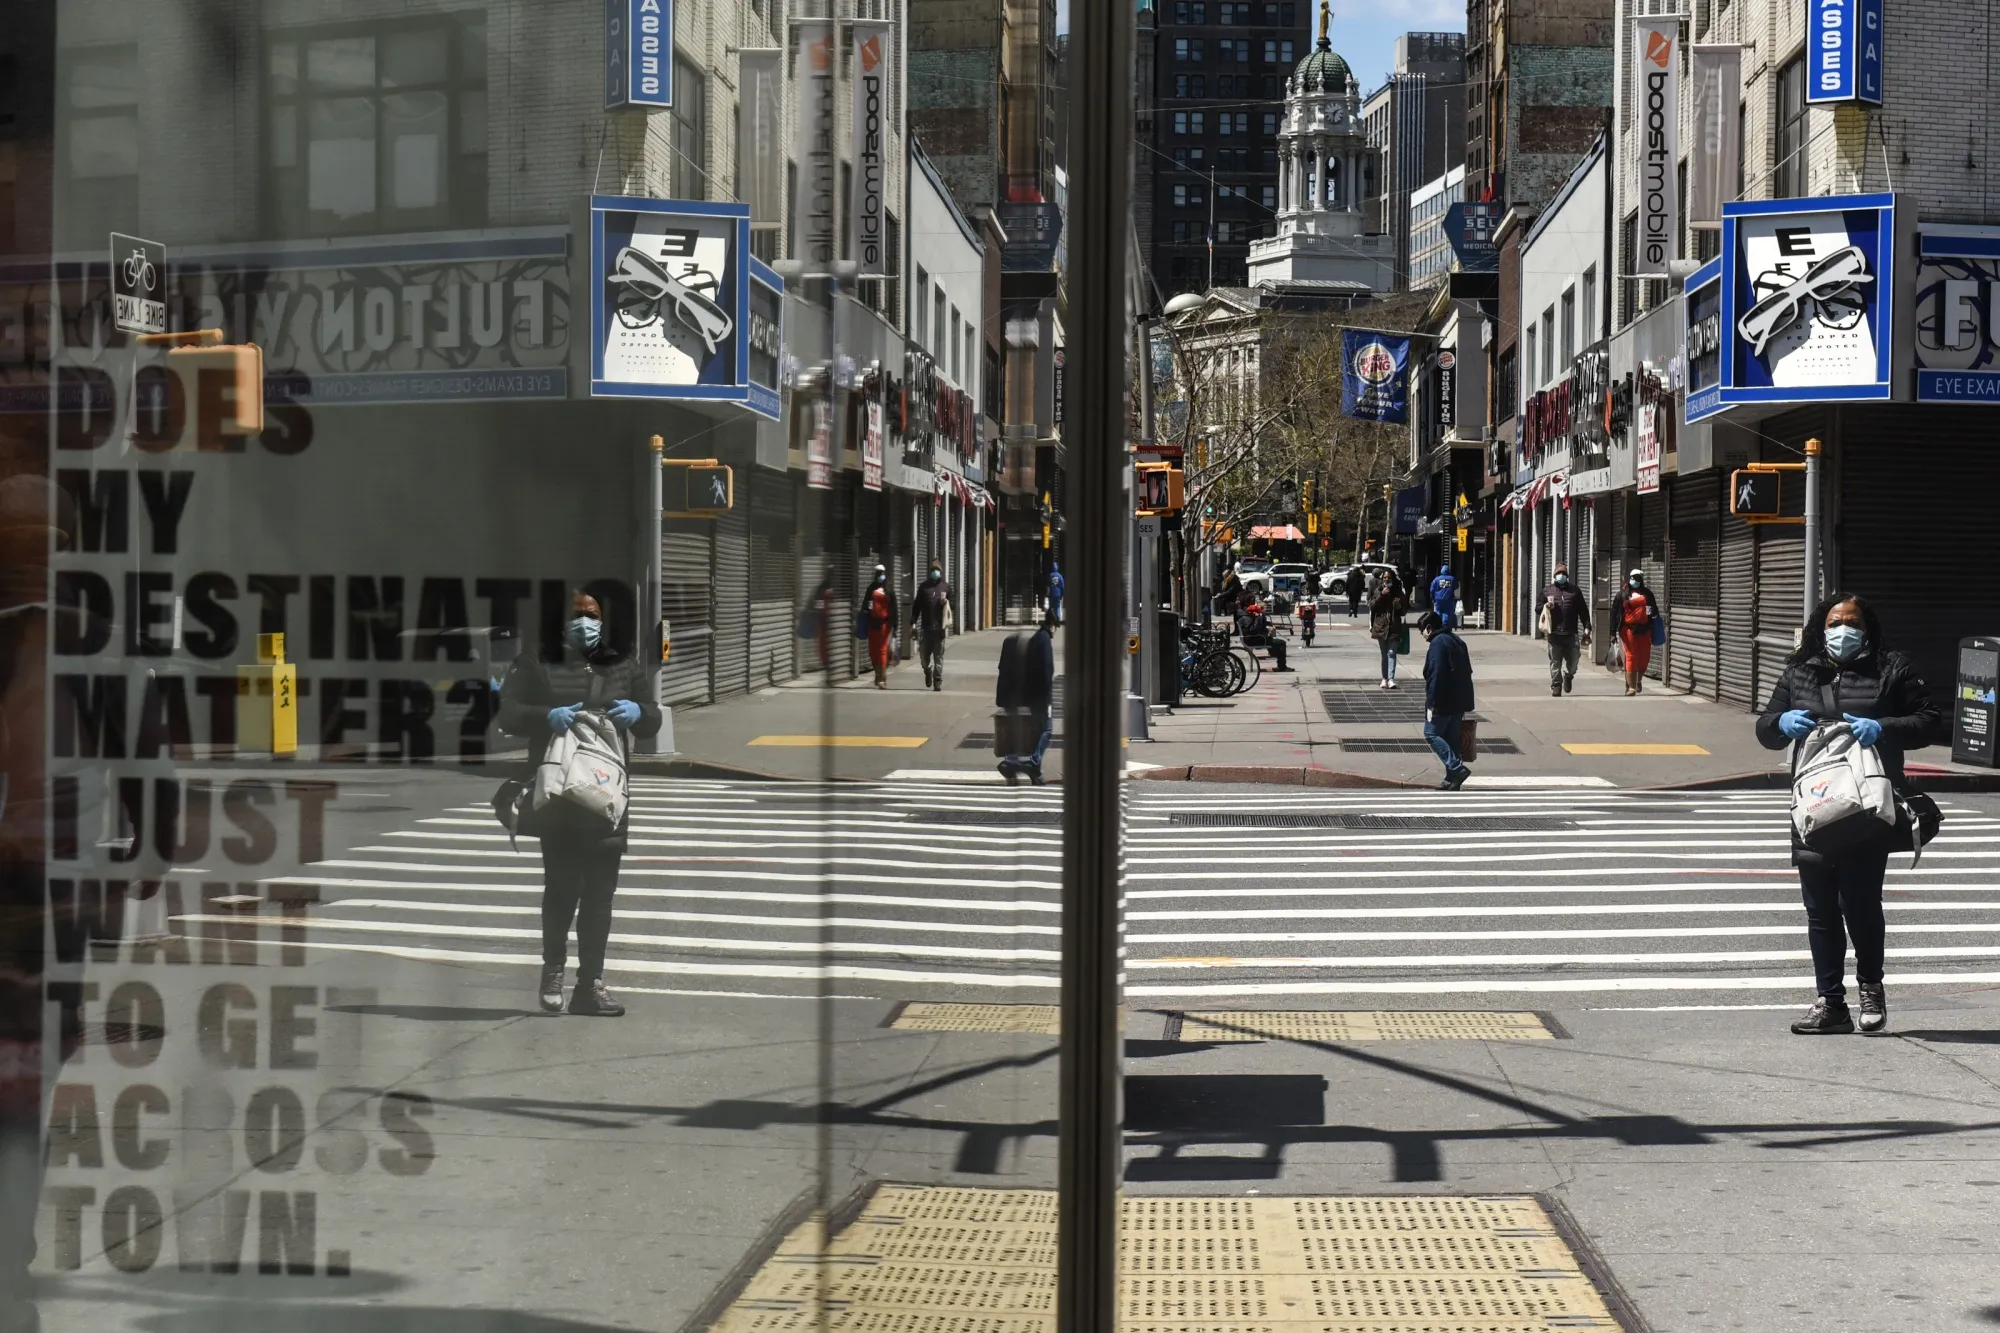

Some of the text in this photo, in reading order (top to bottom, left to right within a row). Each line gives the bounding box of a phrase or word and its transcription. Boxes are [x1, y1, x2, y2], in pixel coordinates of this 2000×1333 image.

[56, 365, 314, 455] DOES
[1936, 377, 1962, 394] EYE
[55, 468, 195, 554] MY
[1139, 524, 1153, 533] SES
[52, 673, 500, 767] MATTER?
[108, 777, 340, 866] JUST
[48, 878, 322, 967] WANT
[46, 979, 379, 1071] TO GET
[48, 1083, 437, 1177] ACROSS
[46, 1184, 352, 1277] TOWN.
